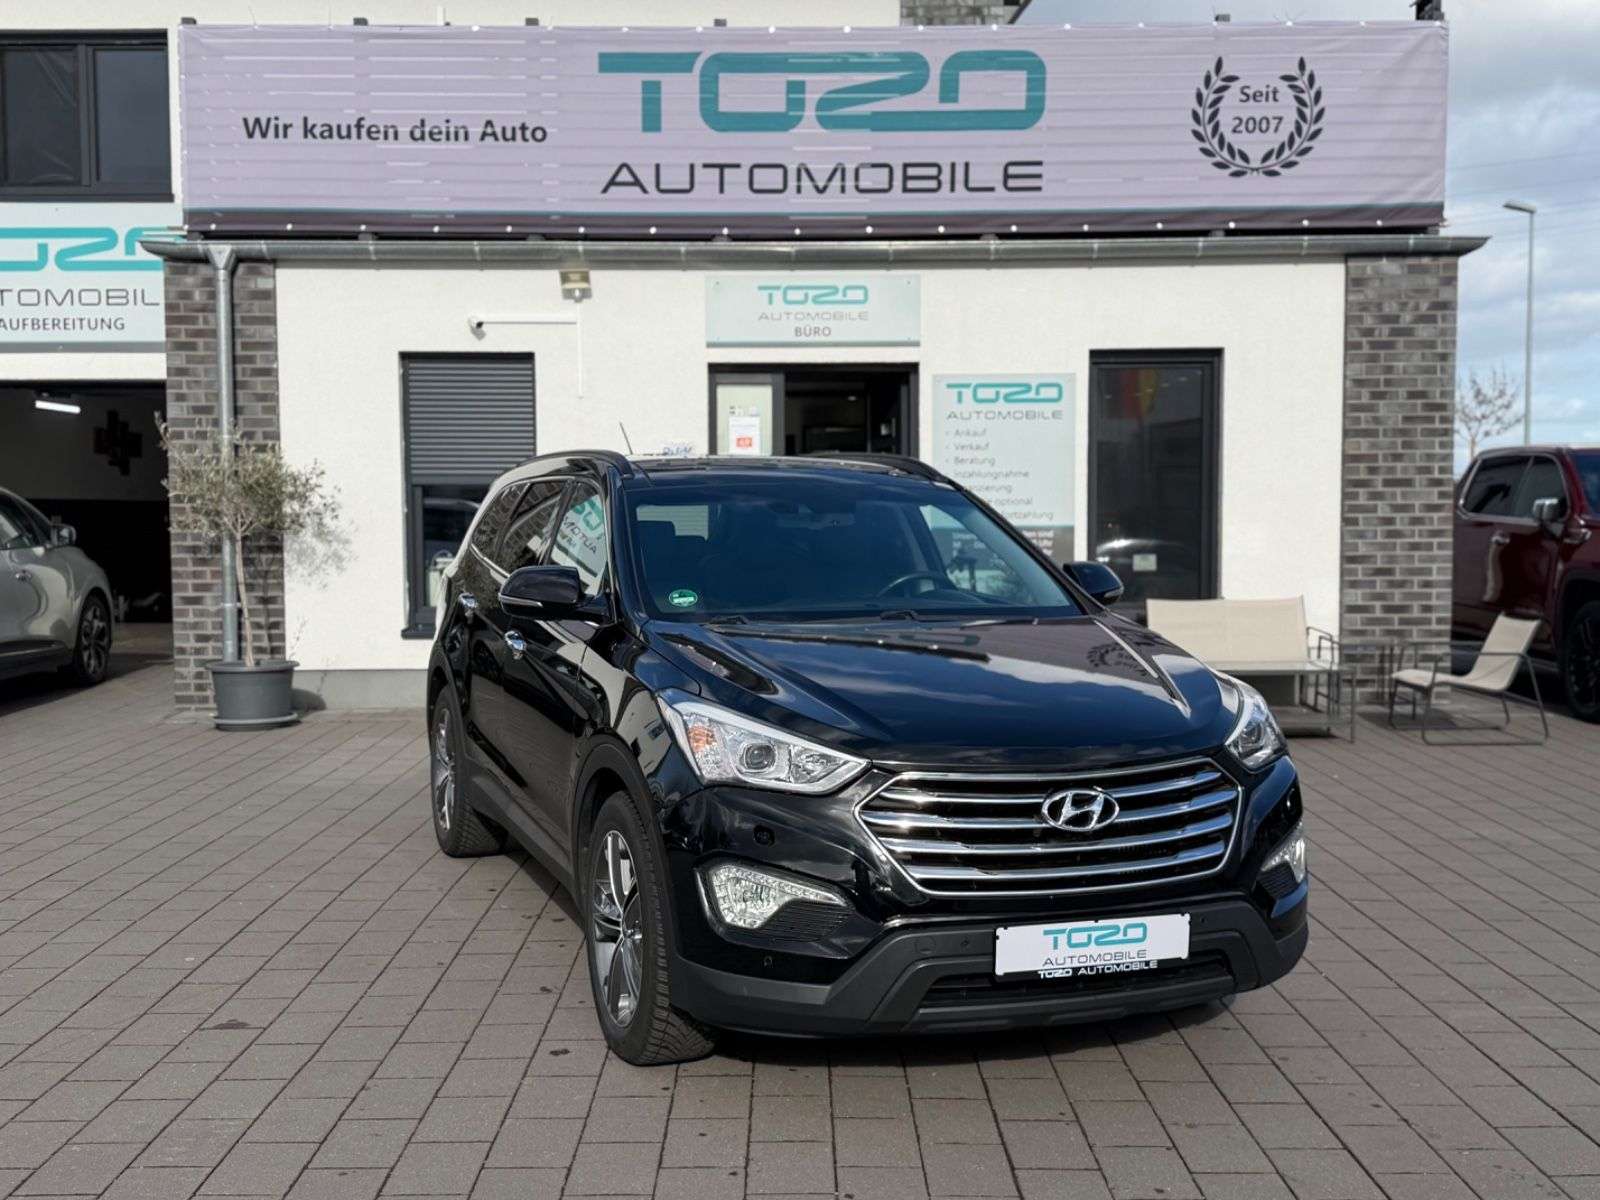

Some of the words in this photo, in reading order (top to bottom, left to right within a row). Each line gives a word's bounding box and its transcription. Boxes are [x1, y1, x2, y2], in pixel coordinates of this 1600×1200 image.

[598, 50, 1046, 132] TOZO
[1239, 84, 1280, 103] Seit
[242, 116, 293, 140] Wir
[302, 116, 399, 141] kaufen
[409, 118, 470, 142] dein
[479, 119, 548, 143] Auto
[1231, 116, 1284, 134] 2007
[600, 160, 1044, 195] AUTOMOBILE
[757, 285, 869, 305] TOZO
[0, 317, 125, 331] AUFBEREITUNG
[758, 311, 869, 321] AUTOMOBILE
[794, 324, 832, 337] BÜRO
[946, 382, 1063, 404] TOZO
[946, 410, 1063, 421] AUTOMOBILE
[954, 428, 987, 437] Ankauf
[954, 442, 989, 451] Verkauf
[954, 456, 995, 467] Beratung
[1043, 922, 1148, 950] TOZO
[1042, 949, 1147, 967] AUTOMOBILE
[1038, 968, 1073, 979] TOZO
[1077, 960, 1157, 976] AUTOMOBILE
